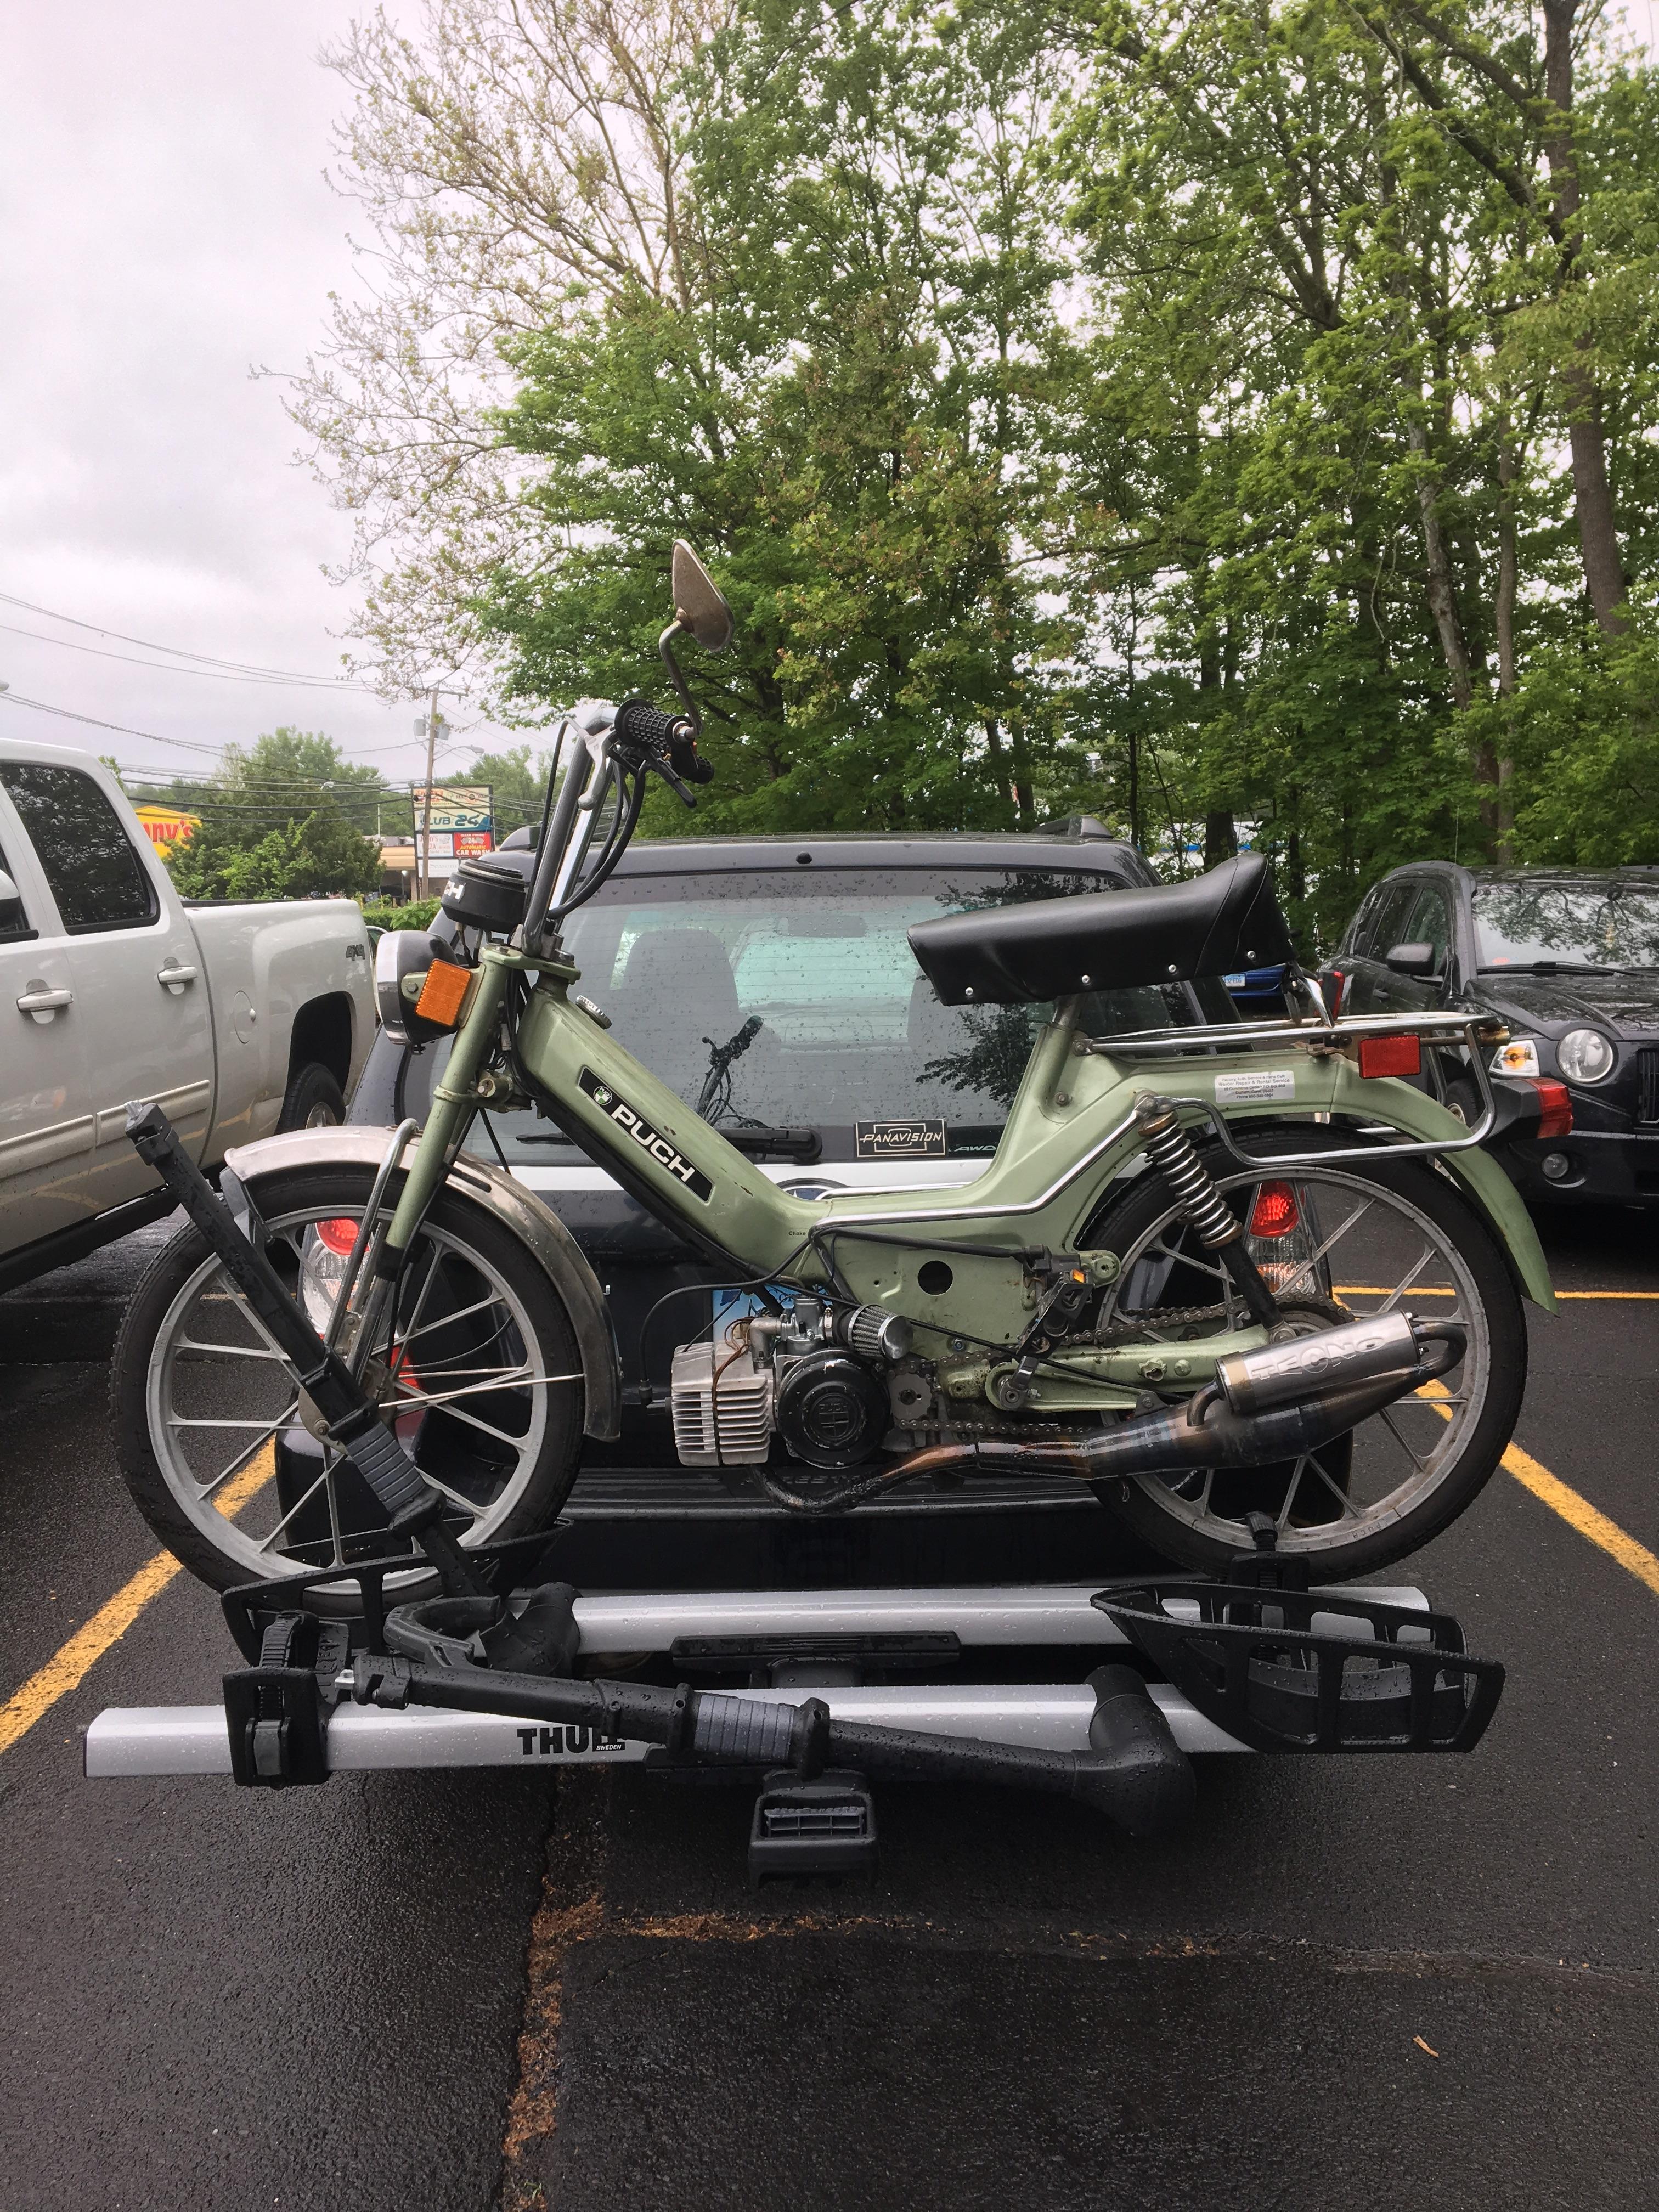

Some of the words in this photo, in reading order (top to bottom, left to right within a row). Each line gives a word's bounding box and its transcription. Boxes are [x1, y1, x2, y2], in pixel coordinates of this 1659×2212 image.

[421, 816, 450, 825] UB
[455, 814, 481, 826] 24
[611, 1103, 696, 1182] PUCH
[859, 1132, 943, 1143] PANAVISION
[1251, 1336, 1385, 1380] TECNO
